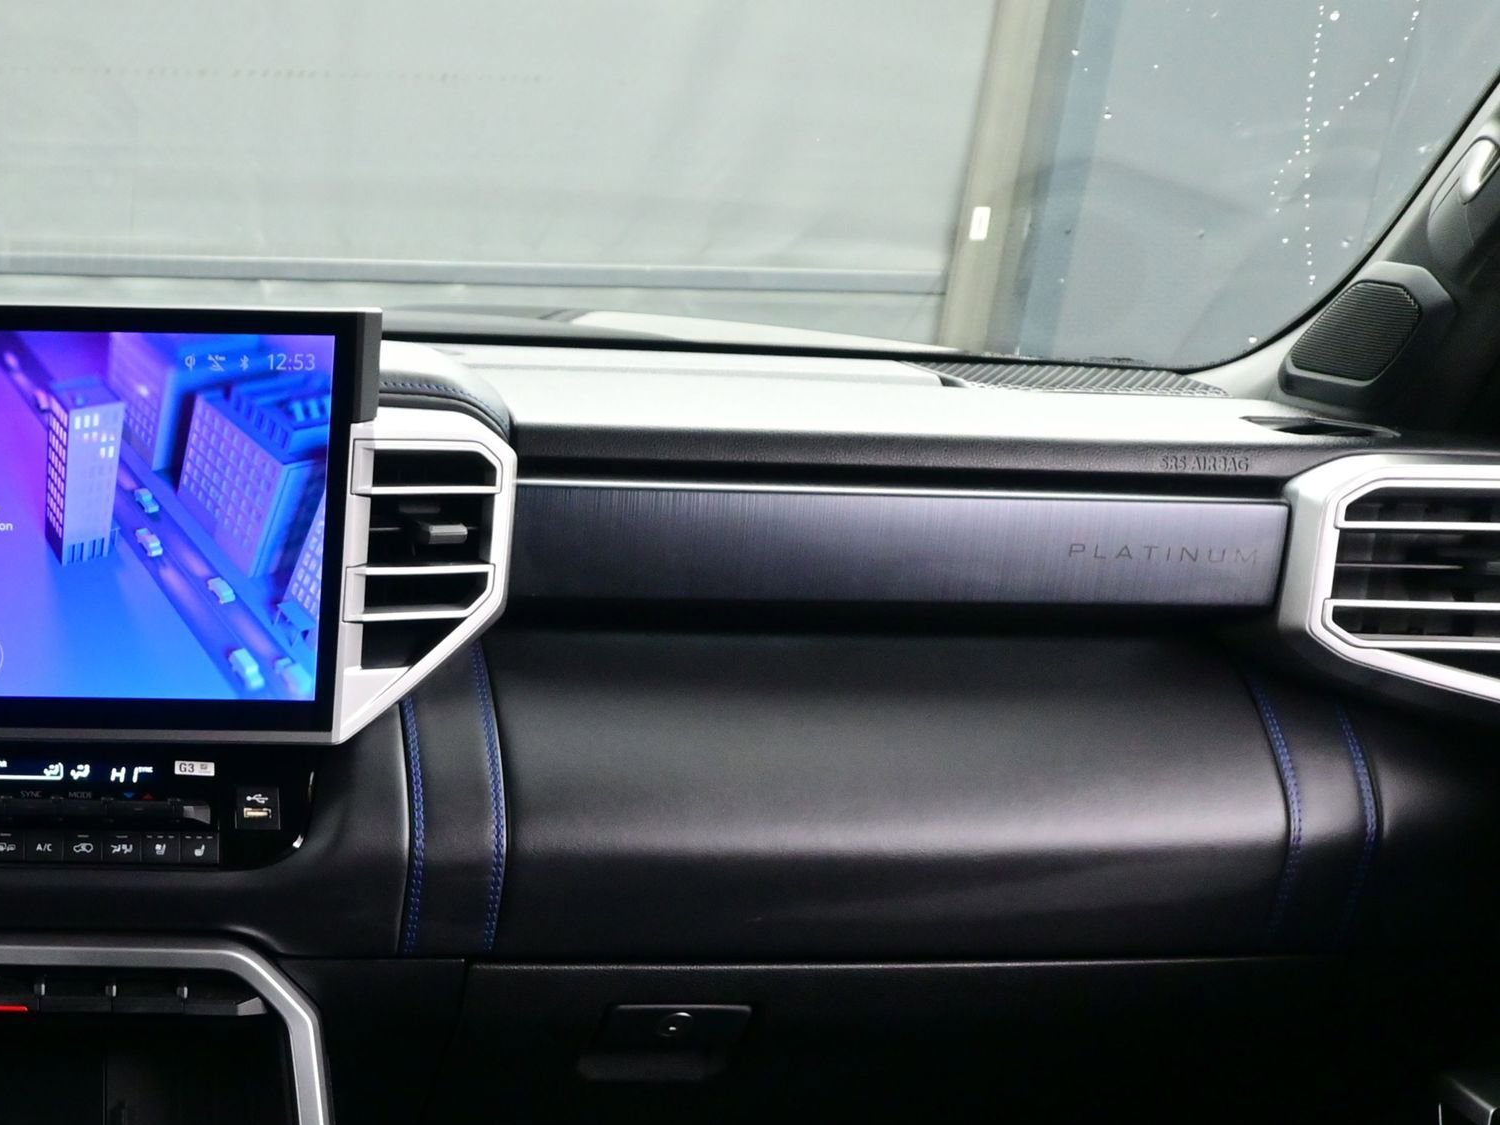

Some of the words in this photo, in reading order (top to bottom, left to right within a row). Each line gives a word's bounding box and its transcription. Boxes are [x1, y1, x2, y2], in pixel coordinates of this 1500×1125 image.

[266, 353, 316, 372] 12:53
[1067, 543, 1259, 564] PLATINUM
[179, 763, 195, 774] G3
[20, 790, 43, 799] SYNC
[68, 791, 92, 800] MODE
[36, 842, 53, 852] A/C
